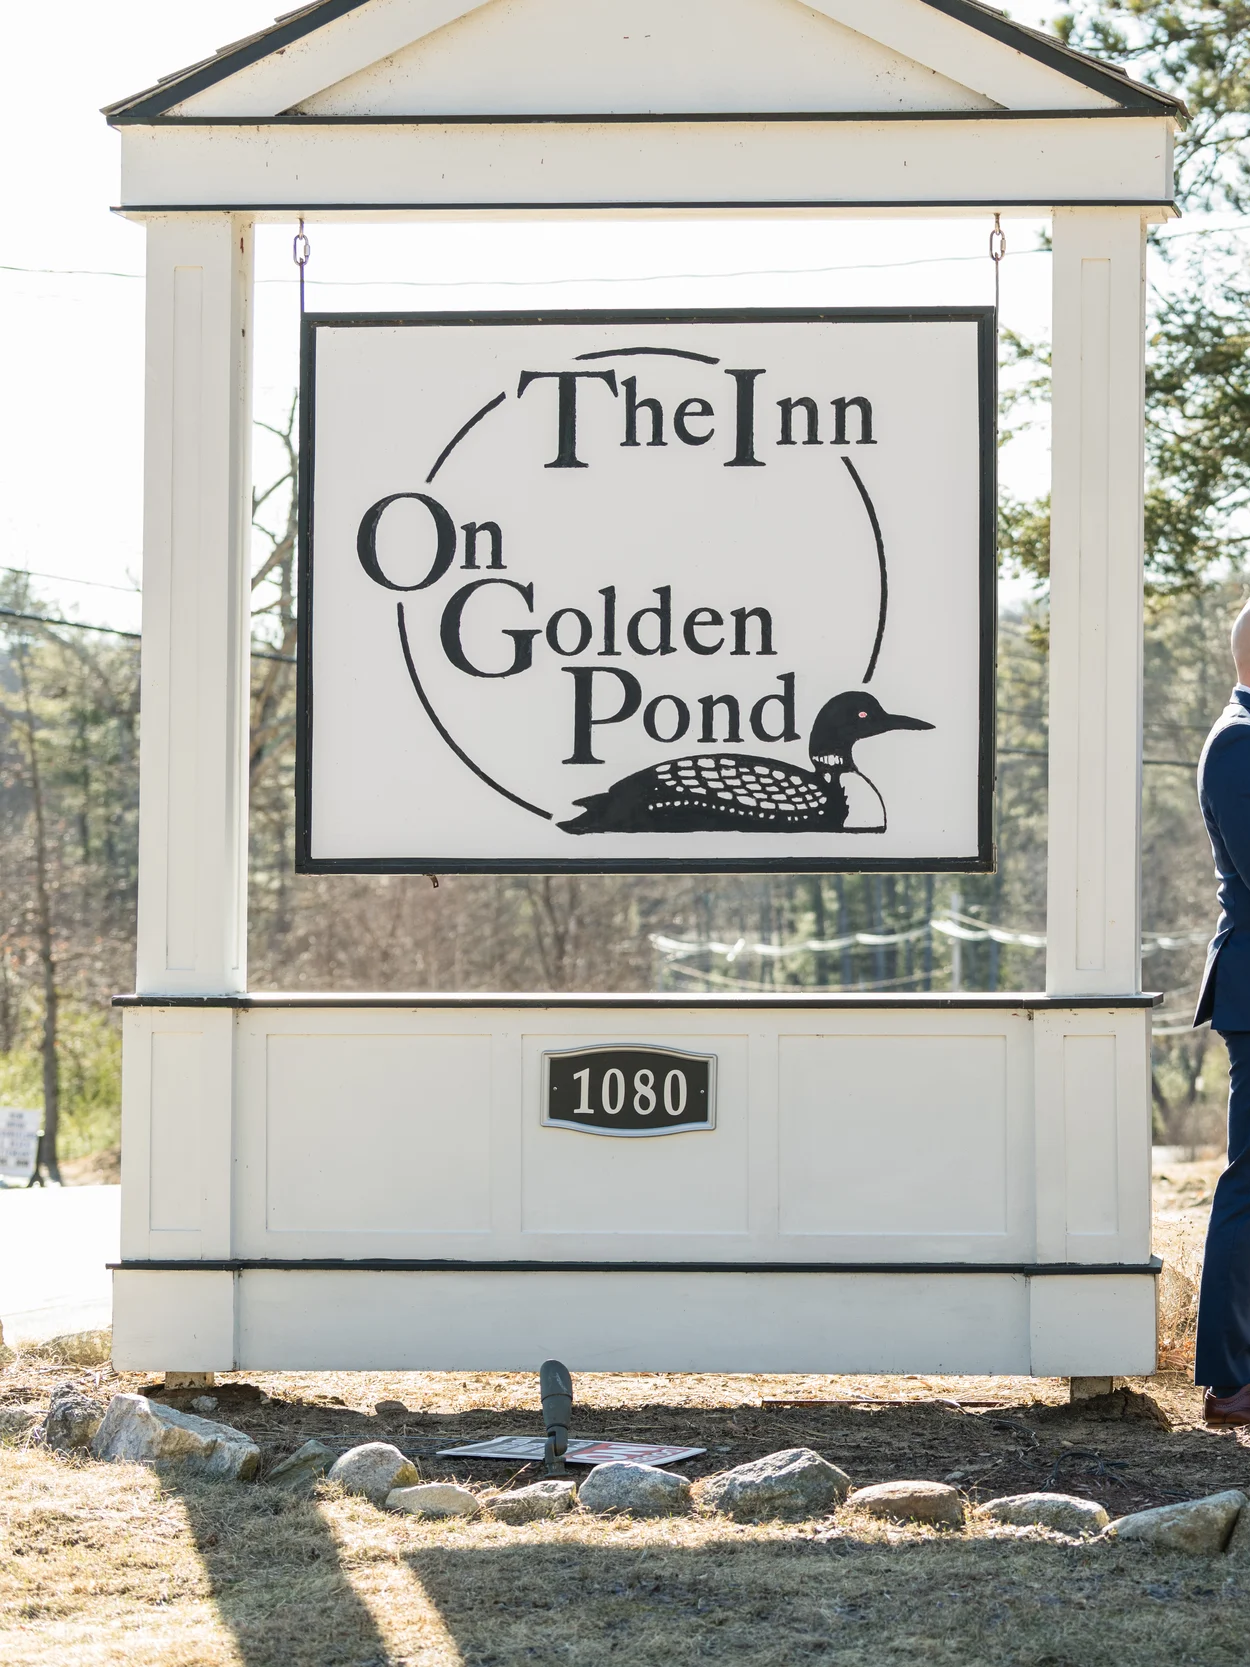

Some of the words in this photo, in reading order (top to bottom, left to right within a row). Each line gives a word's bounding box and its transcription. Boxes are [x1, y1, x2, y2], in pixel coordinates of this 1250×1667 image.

[517, 368, 716, 468] The
[723, 368, 878, 467] Inn
[356, 492, 508, 592] On
[439, 577, 778, 679] Golden
[560, 666, 802, 765] Pond
[572, 1067, 688, 1116] 1080
